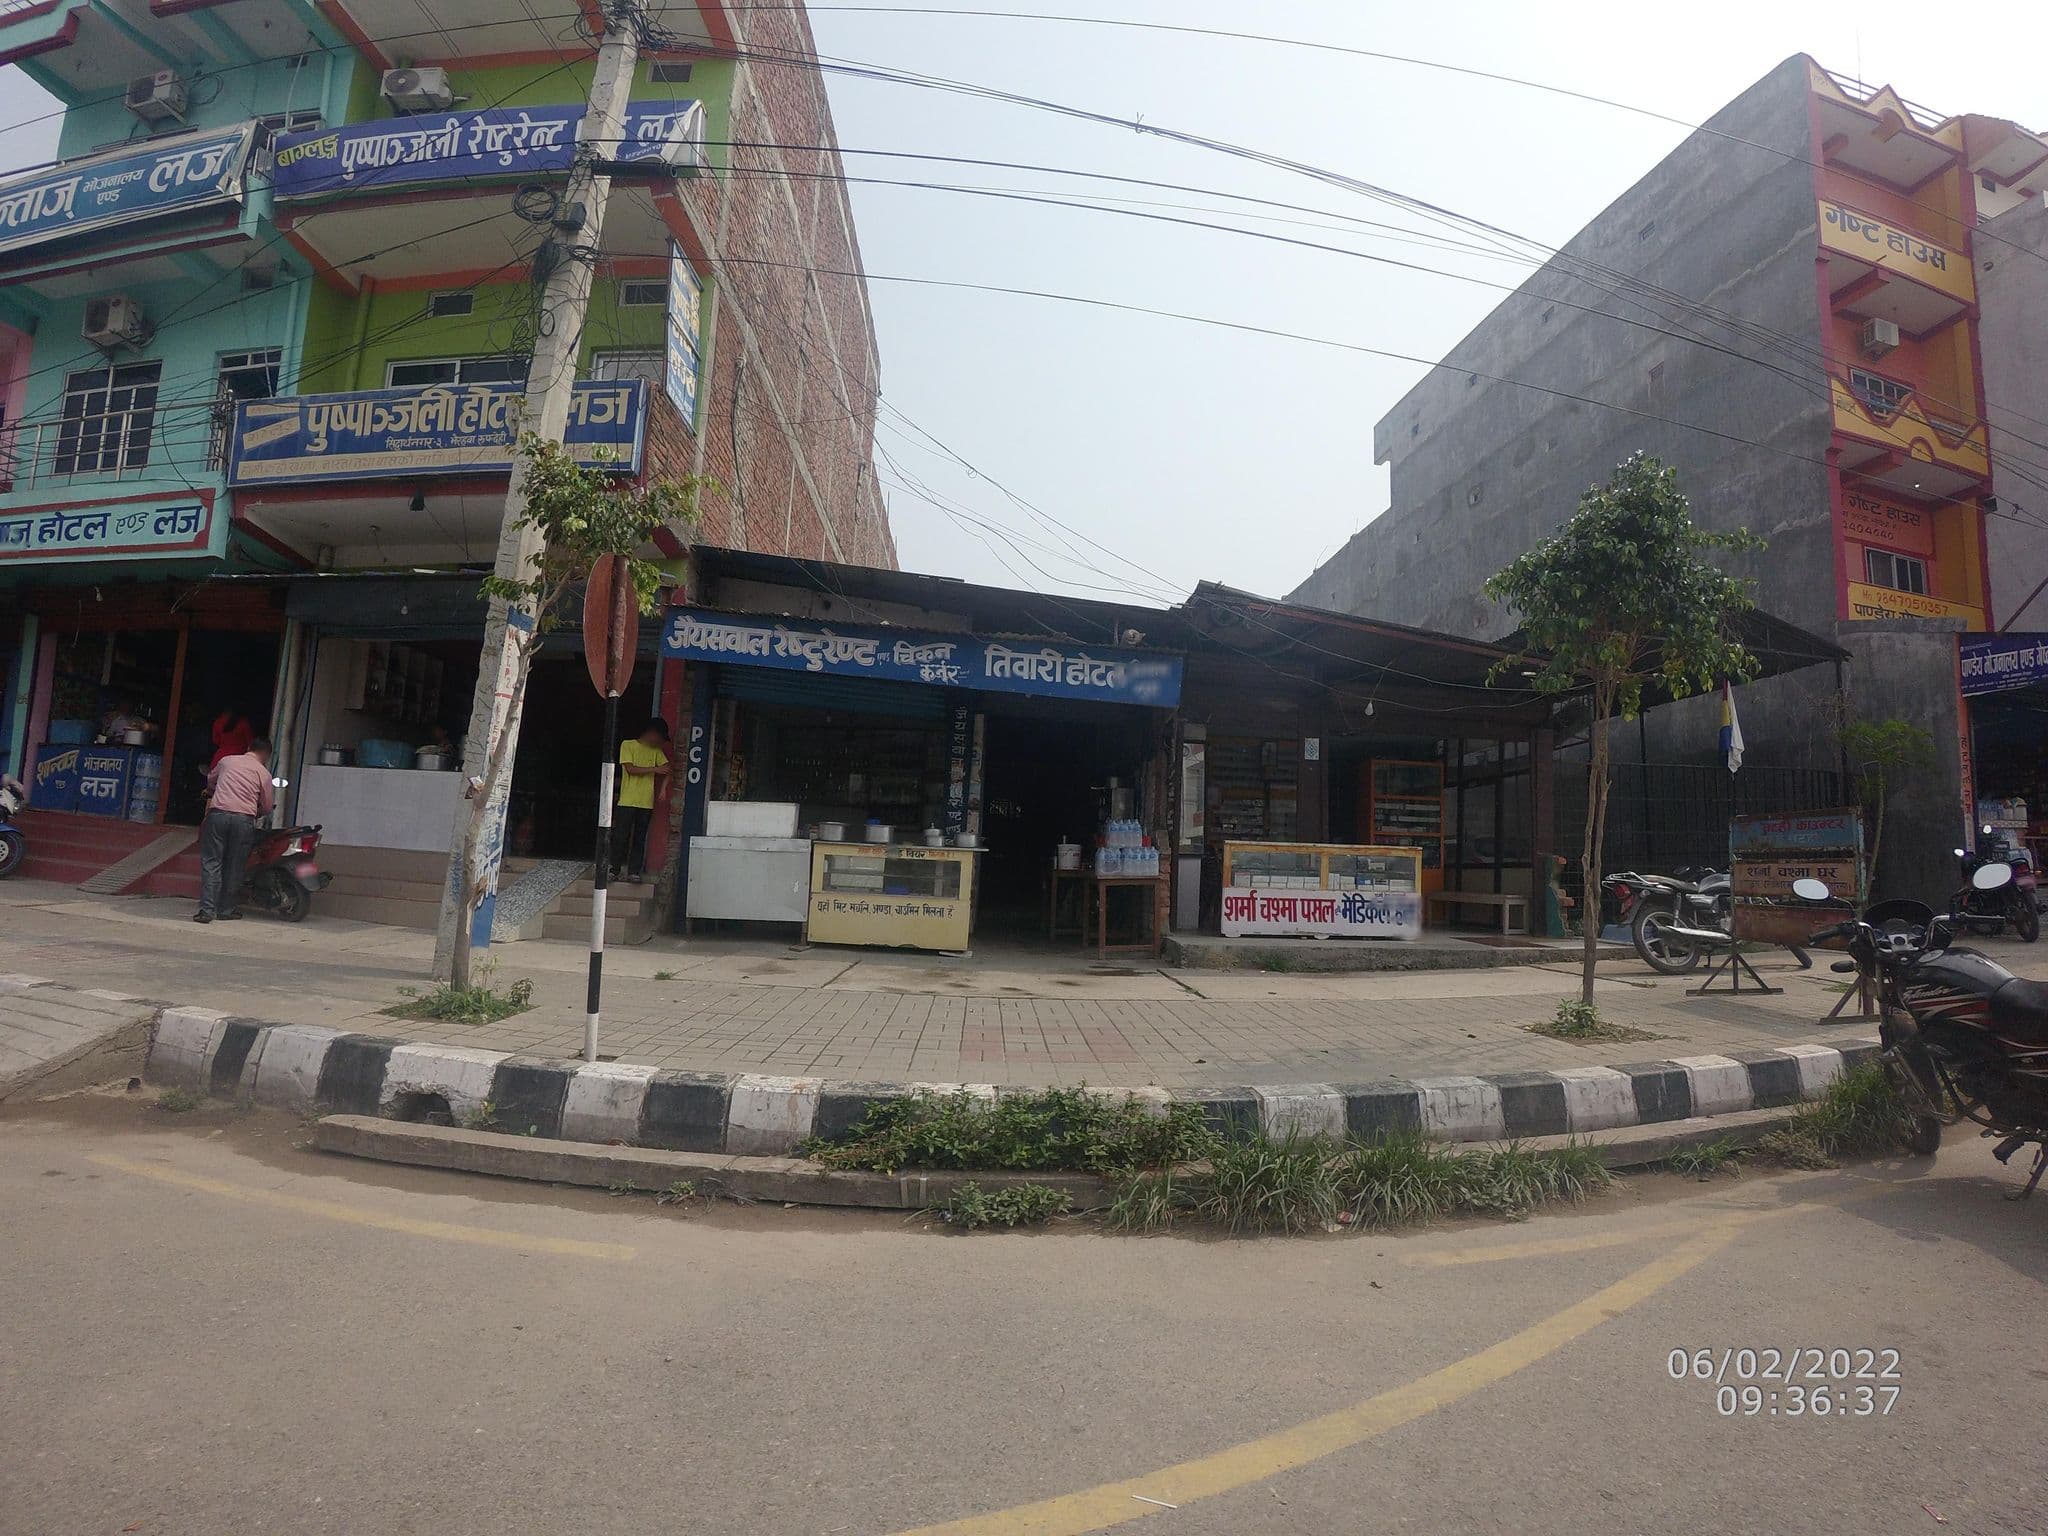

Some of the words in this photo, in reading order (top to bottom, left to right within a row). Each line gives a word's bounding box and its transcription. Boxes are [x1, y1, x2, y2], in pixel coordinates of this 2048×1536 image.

[148, 142, 237, 194] लज
[1886, 228, 1947, 272] हाउस
[38, 511, 111, 543] होटल
[153, 505, 202, 536] लज
[984, 643, 1066, 683] तिवारी
[687, 726, 704, 784] PCO
[80, 776, 120, 799] लज
[1224, 889, 1258, 922] शर्मा
[1260, 897, 1299, 923] चश्मा
[1300, 898, 1336, 924] पसल
